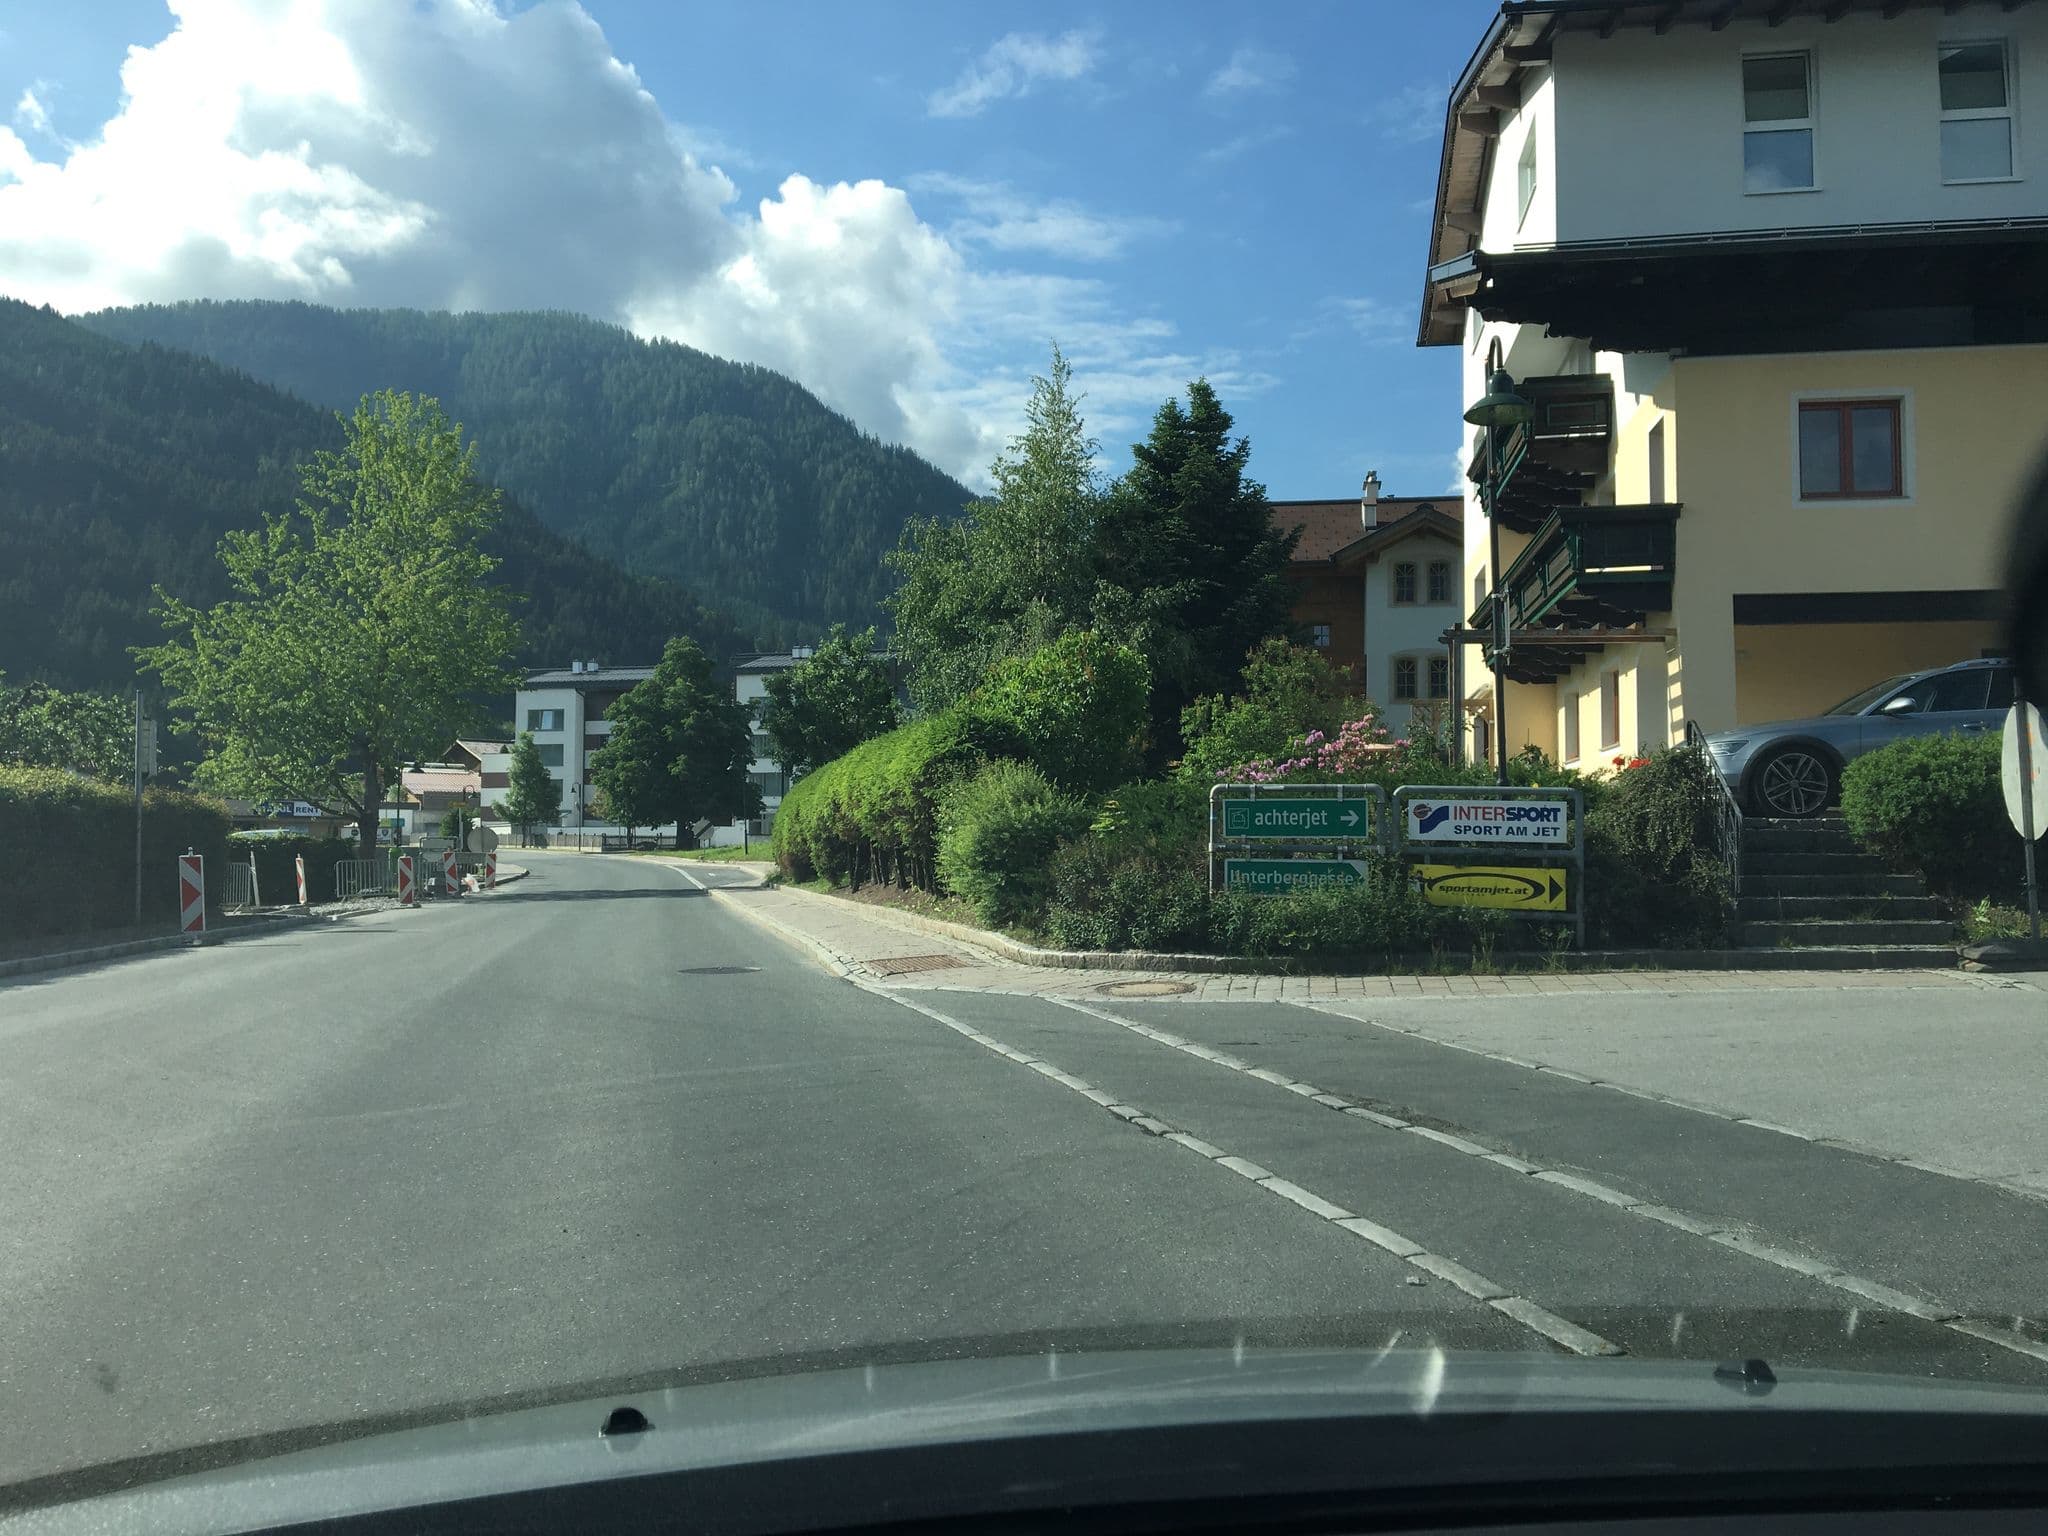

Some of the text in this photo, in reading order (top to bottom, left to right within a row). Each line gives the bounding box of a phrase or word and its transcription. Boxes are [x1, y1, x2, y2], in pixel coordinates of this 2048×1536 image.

[1254, 808, 1328, 829] achterjet
[1453, 805, 1561, 822] INTERSPORT
[1454, 825, 1560, 837] SPORT AM JET
[1230, 869, 1354, 888] Unterberggasse
[1438, 884, 1529, 896] sportamjet.at
